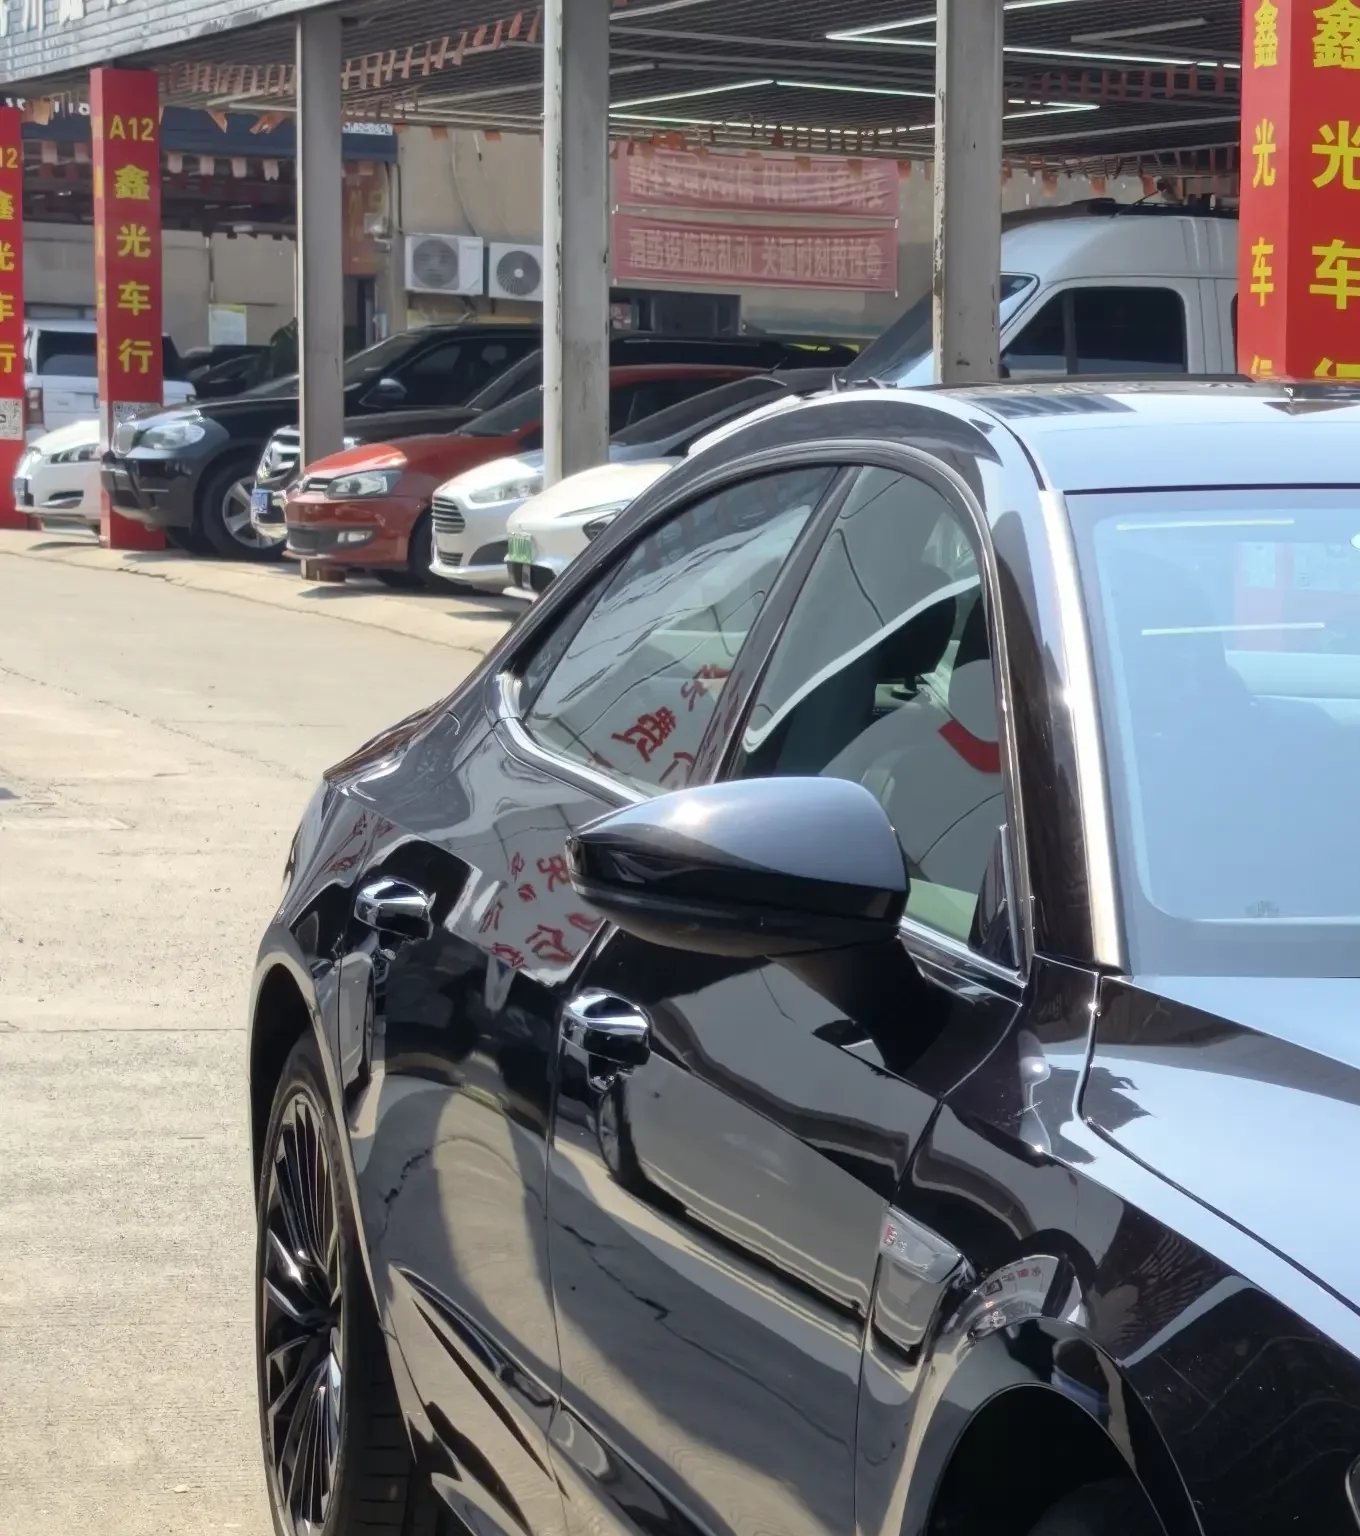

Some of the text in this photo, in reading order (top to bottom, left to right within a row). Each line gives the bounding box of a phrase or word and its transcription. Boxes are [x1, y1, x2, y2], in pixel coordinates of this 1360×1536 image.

[109, 114, 155, 142] A12
[114, 164, 153, 375] 鑫光车行
